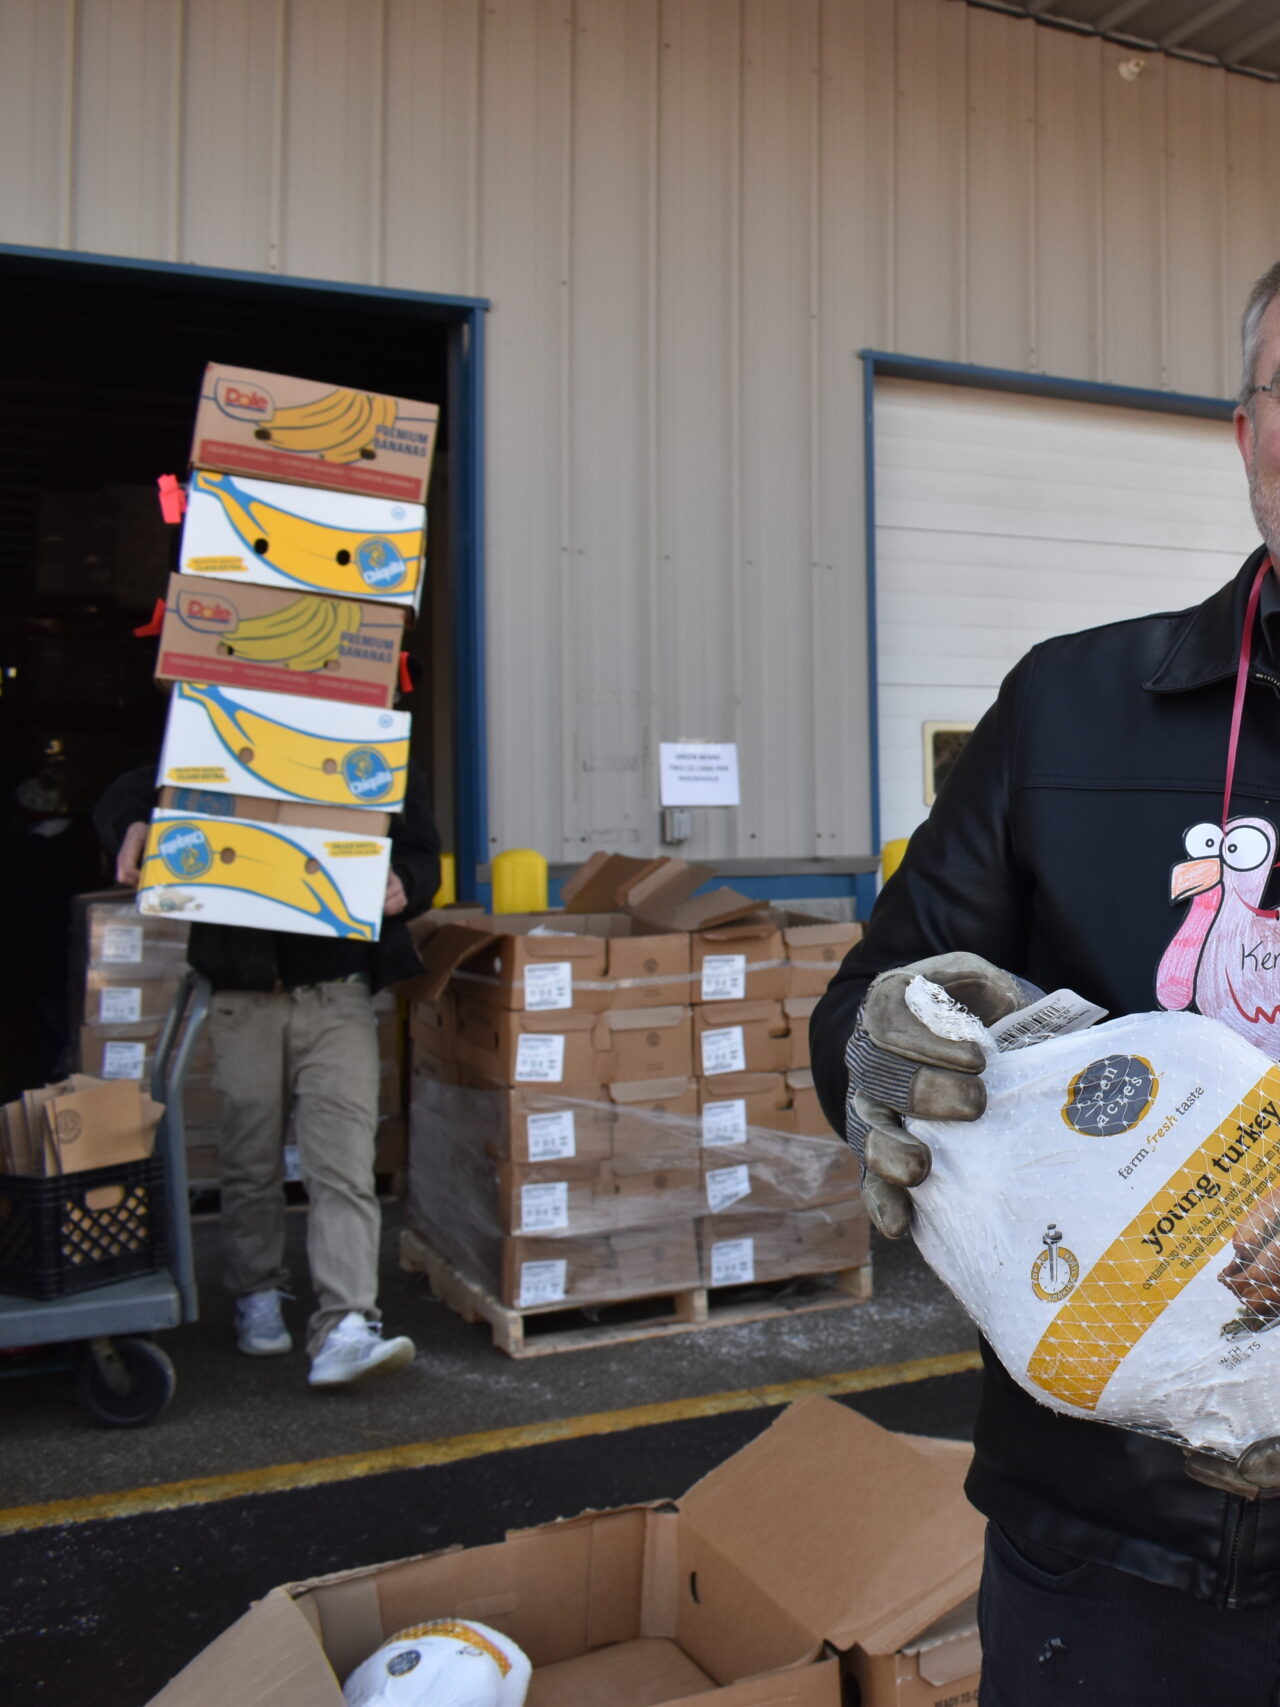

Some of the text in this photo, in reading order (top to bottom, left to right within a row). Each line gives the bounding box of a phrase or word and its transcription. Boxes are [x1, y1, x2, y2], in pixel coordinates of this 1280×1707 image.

[225, 387, 268, 410] Dole
[374, 424, 429, 444] PREMIUM
[373, 438, 427, 459] BANANAS
[363, 561, 406, 584] Chiquita
[187, 599, 232, 621] Dole
[340, 631, 394, 650] PREMIUM
[339, 644, 393, 665] BANANAS
[350, 771, 393, 794] Chiquita
[1096, 1076, 1143, 1126] acres
[1118, 1086, 1205, 1180] farm fresh taste
[1141, 1174, 1222, 1255] young
[1142, 1258, 1171, 1290] contains
[1168, 1248, 1180, 1262] up
[1200, 1205, 1226, 1229] tukey
[1253, 1151, 1275, 1175] sodum
[1180, 1245, 1204, 1269] naural
[1225, 1340, 1261, 1372] GIBLTS
